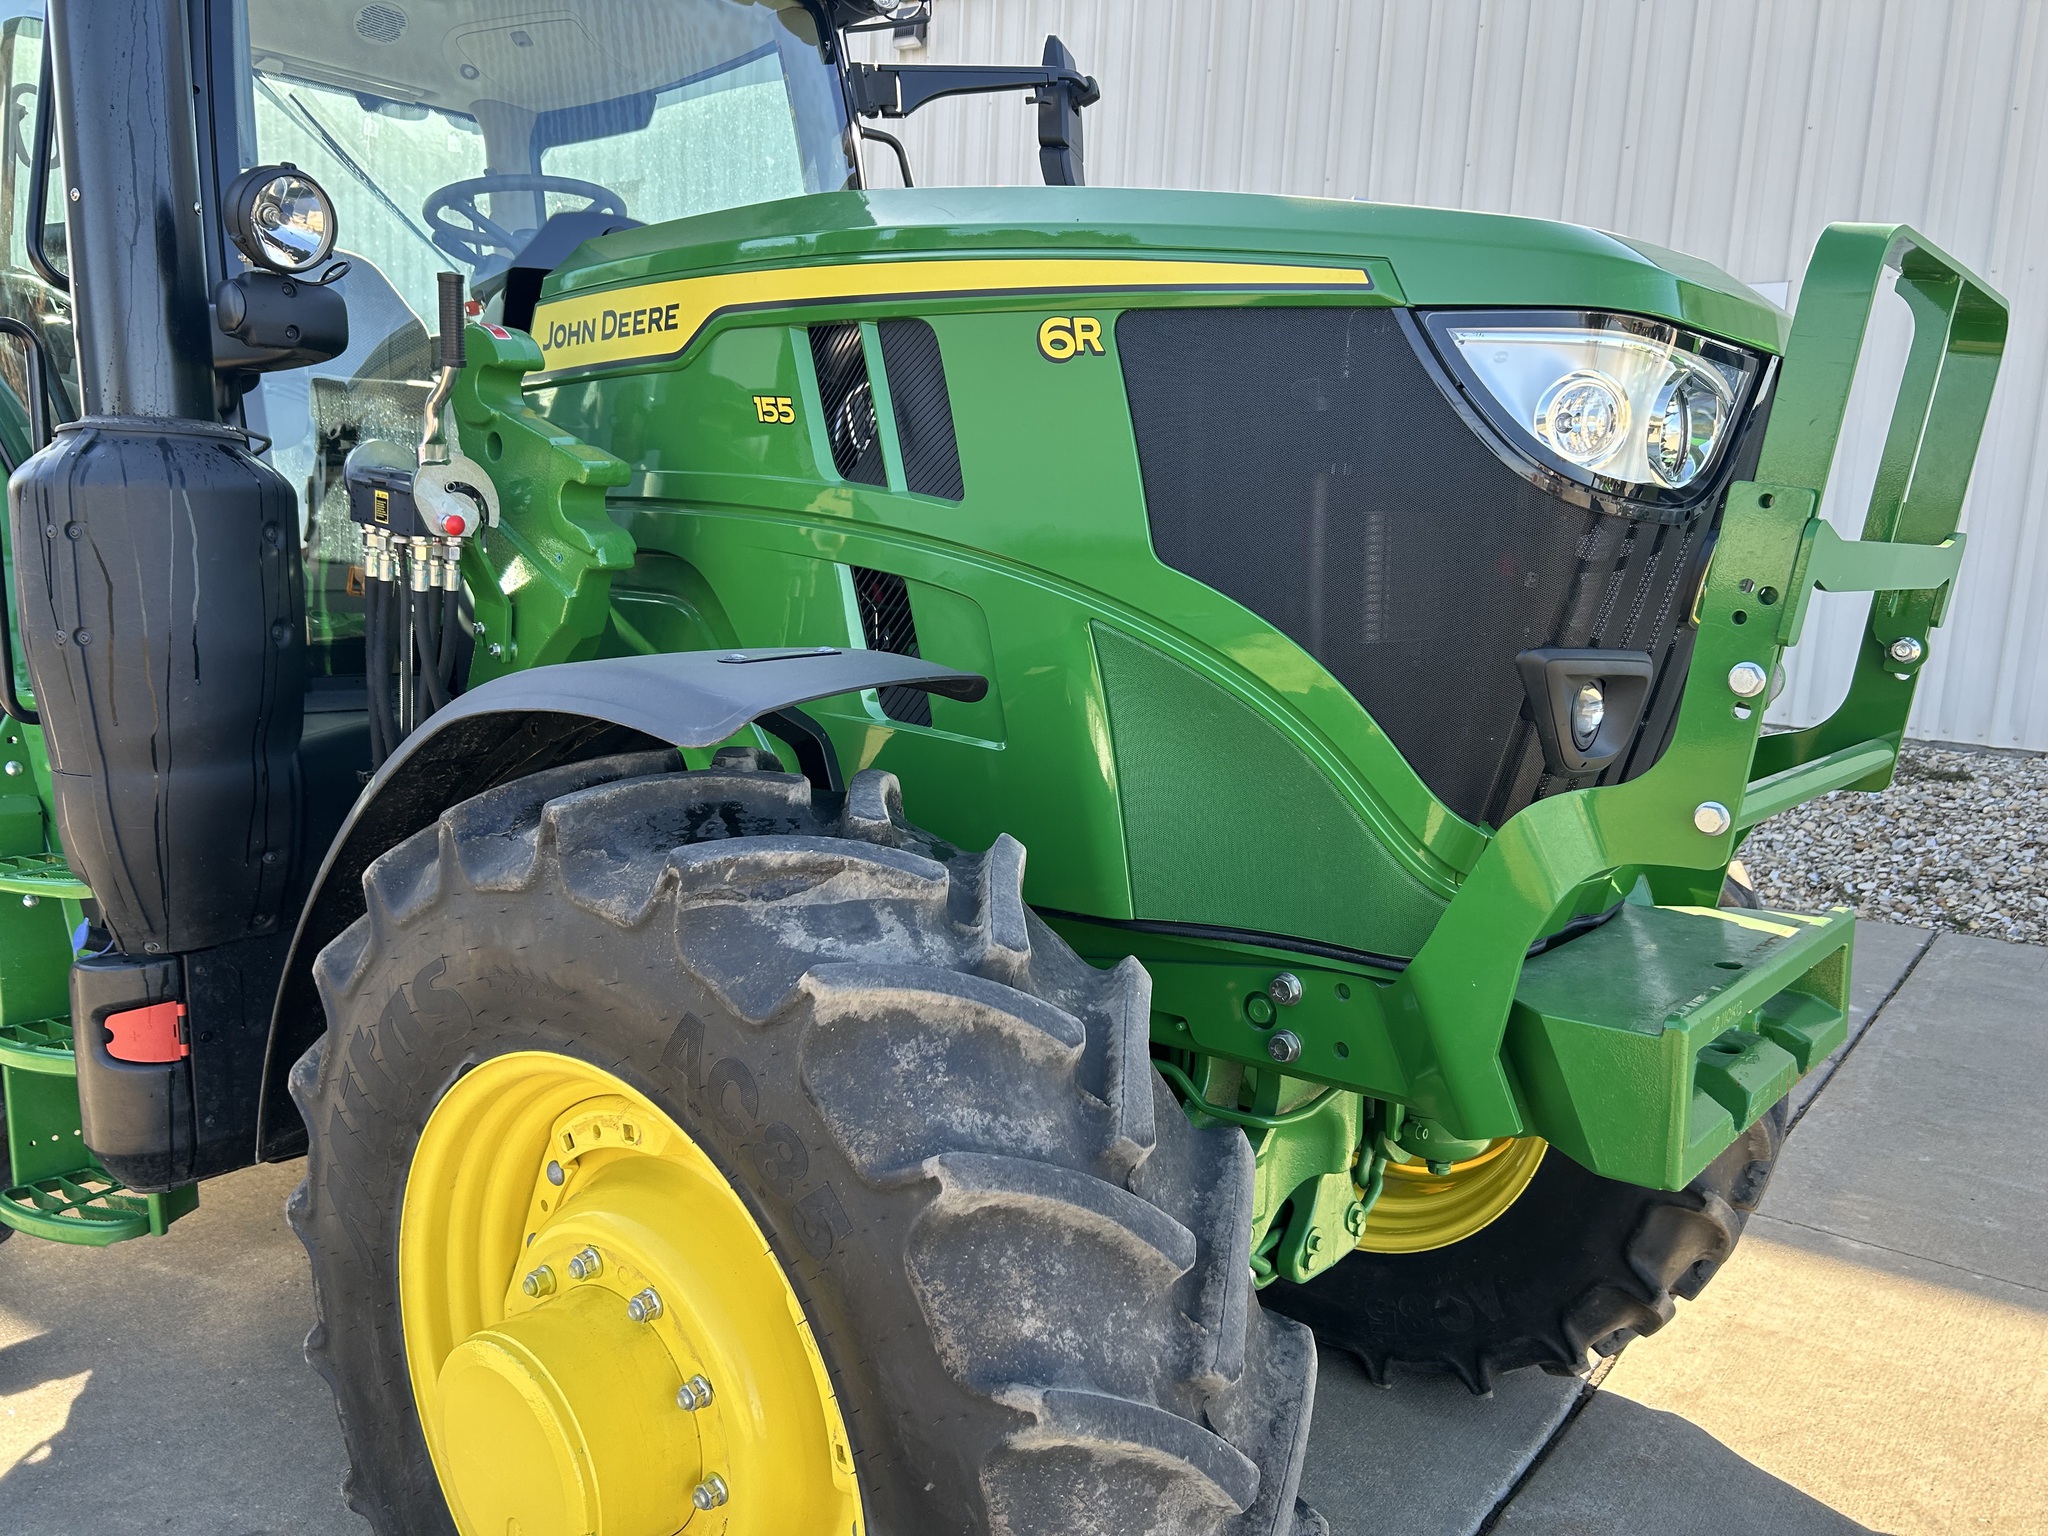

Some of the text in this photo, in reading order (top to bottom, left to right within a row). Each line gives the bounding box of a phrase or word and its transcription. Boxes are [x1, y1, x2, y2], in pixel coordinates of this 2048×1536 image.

[542, 302, 681, 351] JOHN DEERE
[1037, 315, 1106, 364] 6R
[752, 395, 796, 425] 155
[659, 1010, 854, 1263] AC85
